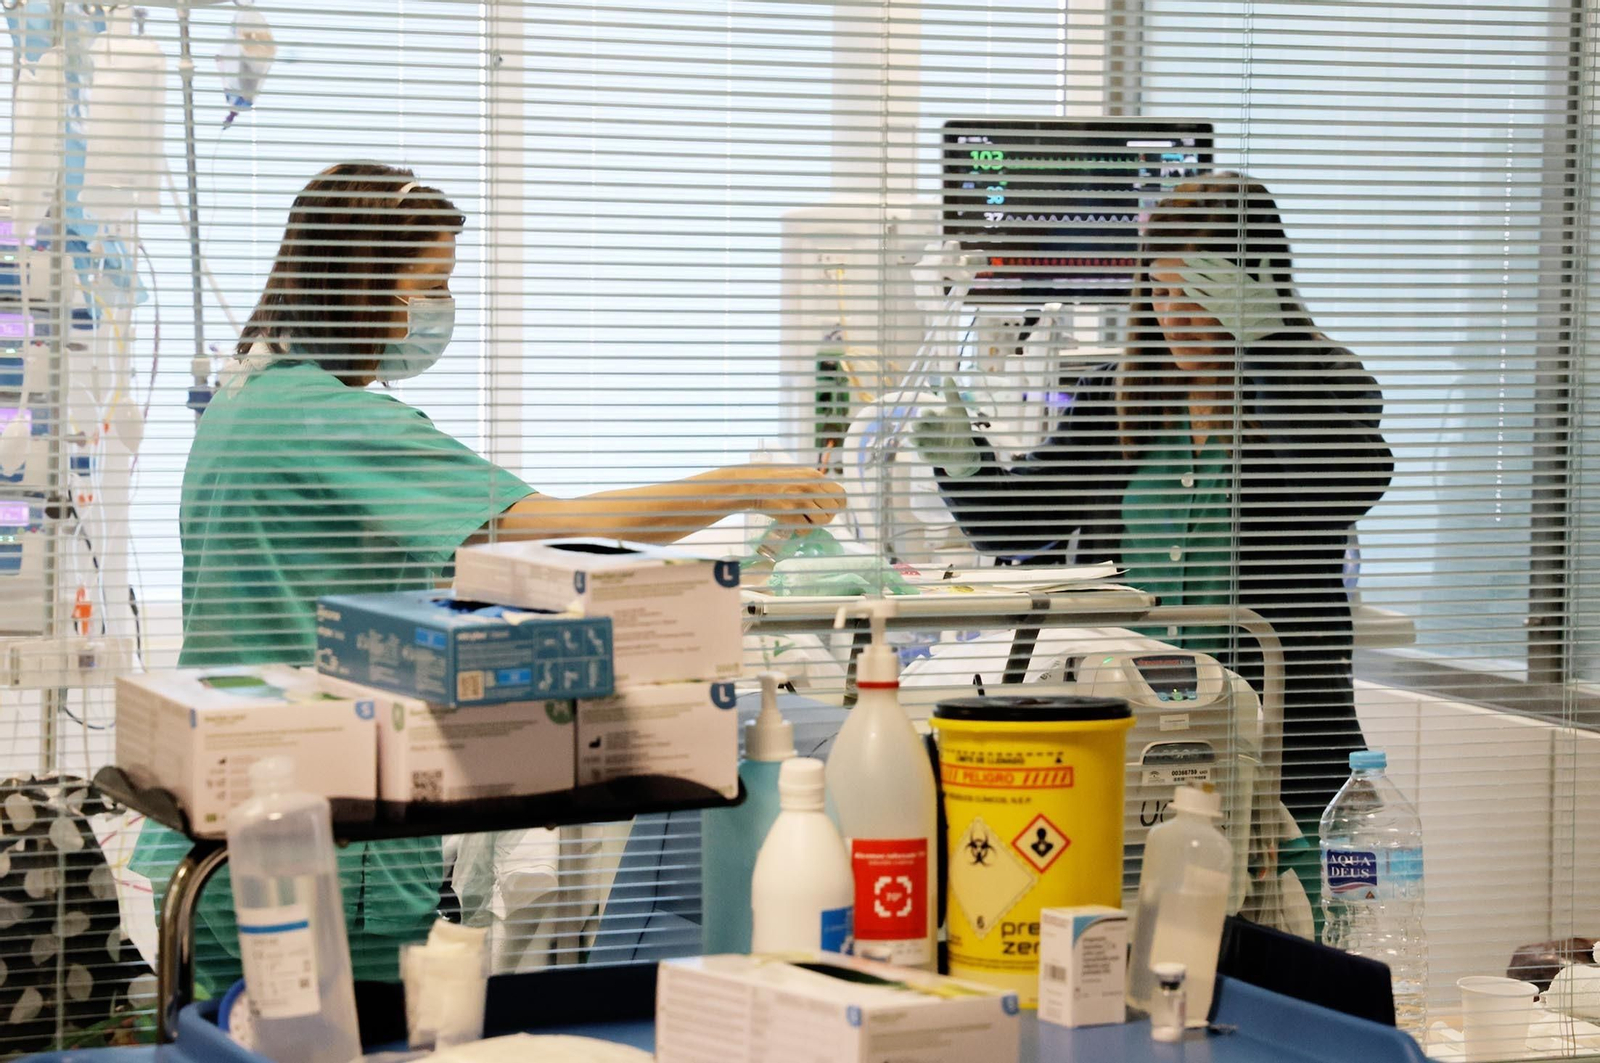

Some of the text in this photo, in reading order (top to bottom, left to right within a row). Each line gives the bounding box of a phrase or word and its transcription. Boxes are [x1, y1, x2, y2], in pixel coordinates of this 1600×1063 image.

[970, 151, 1004, 170] 103
[963, 770, 1014, 784] PELIGRO
[1330, 854, 1371, 867] AQUA
[1331, 866, 1370, 878] DEUS
[1001, 922, 1041, 939] pre
[1002, 941, 1041, 955] zer
